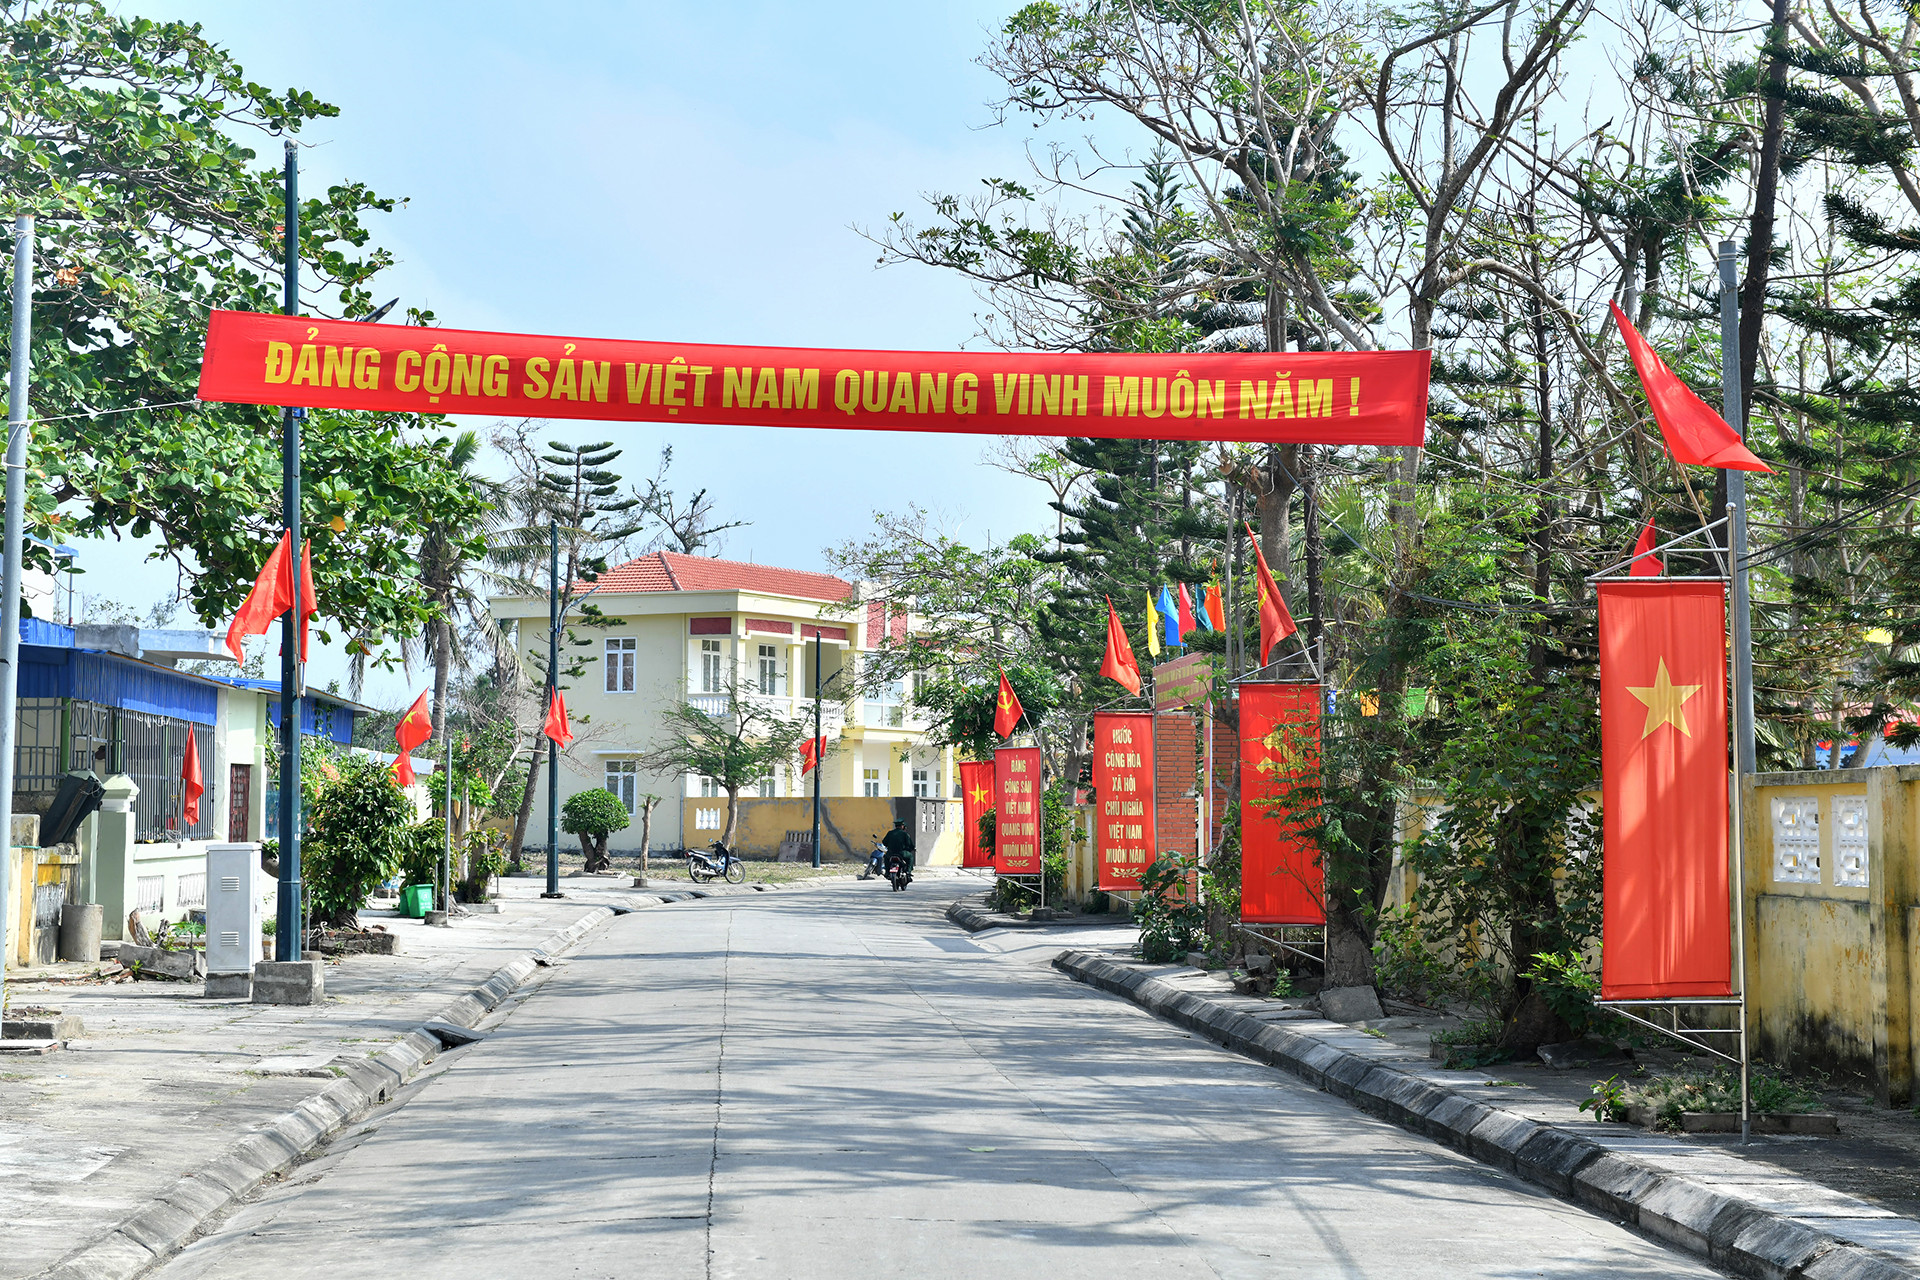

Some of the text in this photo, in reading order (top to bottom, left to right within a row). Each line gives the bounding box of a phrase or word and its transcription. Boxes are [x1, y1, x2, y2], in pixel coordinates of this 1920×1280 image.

[264, 326, 1361, 420] ĐẢNG CỘNG SẢN VIỆT NAM QUANG VINH MUÔN NĂM !
[1112, 725, 1132, 744] NƯỚC
[1105, 750, 1141, 771] CỘNG HÒA
[1004, 776, 1032, 797] CỘNG SẢN
[1112, 774, 1136, 795] XÃ HỘI
[1005, 799, 1031, 817] VIỆT NAM
[1105, 795, 1144, 816] CHỦ NGHĨA
[1001, 822, 1020, 837] QUANG
[1108, 821, 1142, 842] VIỆT NAM
[1105, 845, 1145, 864] MUÔN NĂM
